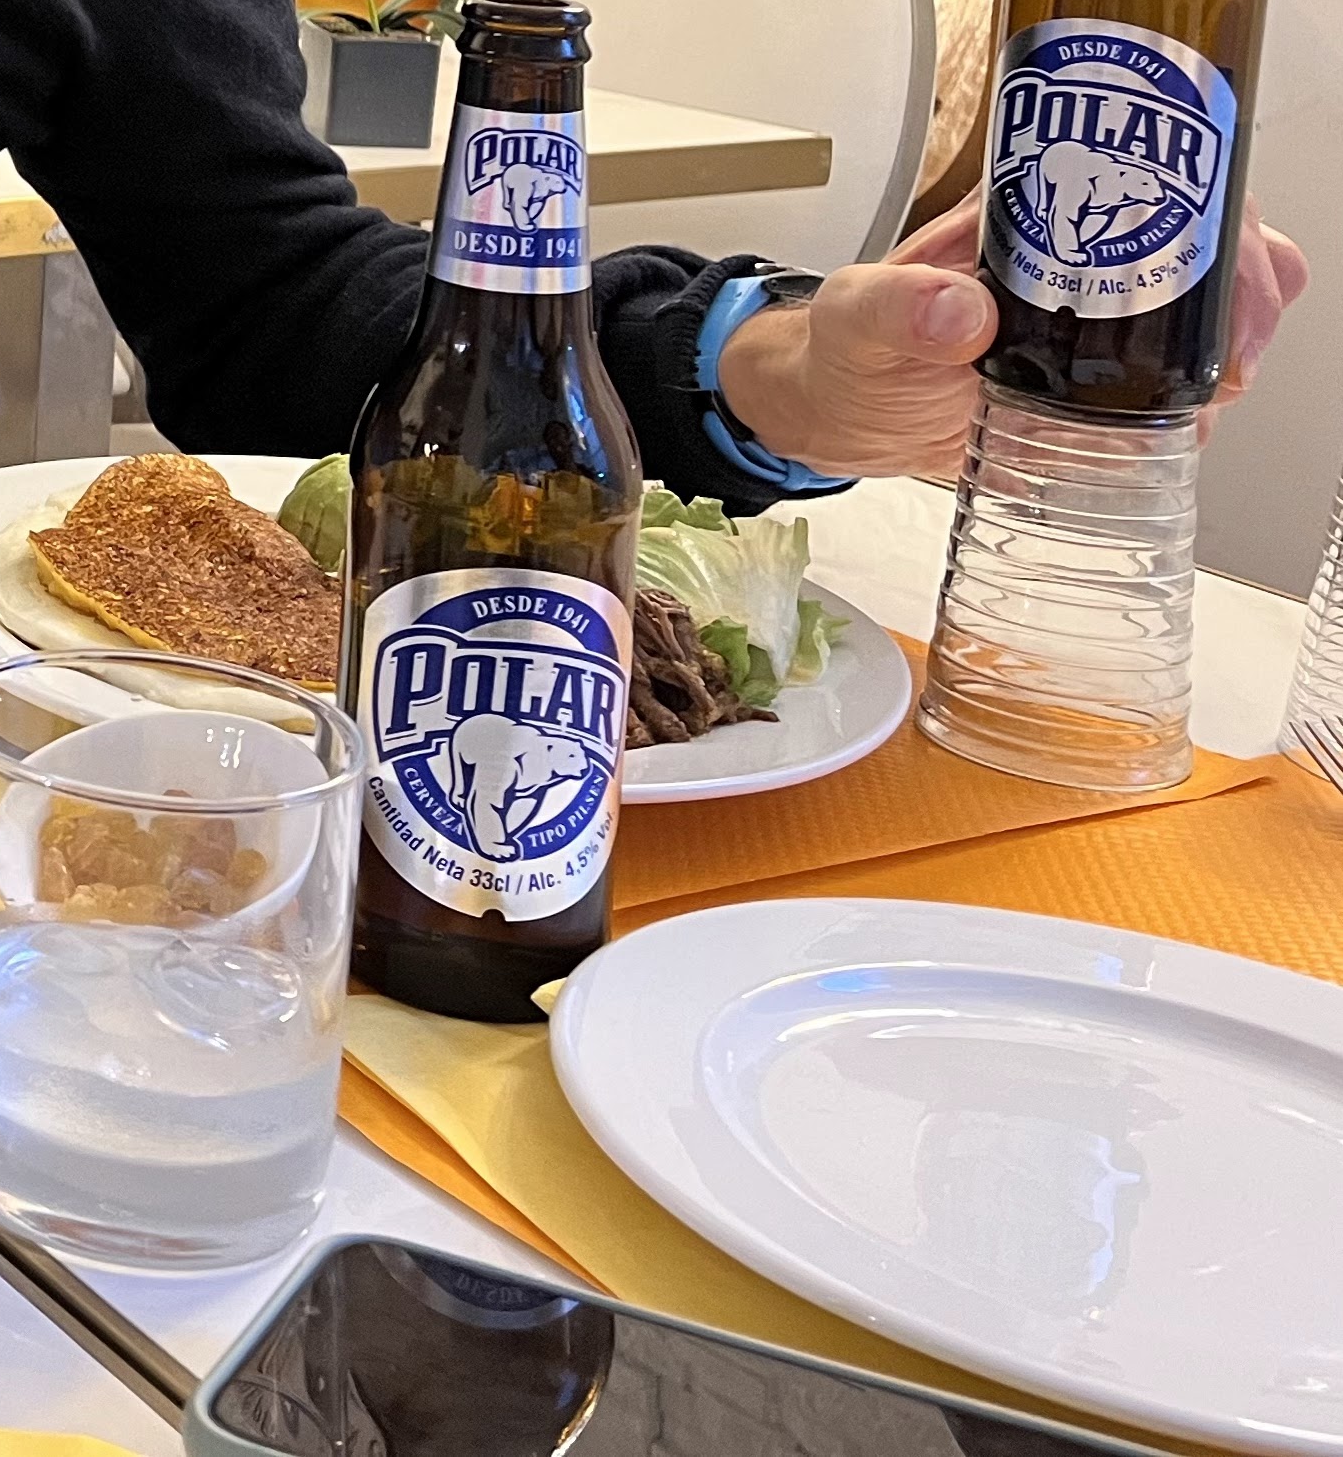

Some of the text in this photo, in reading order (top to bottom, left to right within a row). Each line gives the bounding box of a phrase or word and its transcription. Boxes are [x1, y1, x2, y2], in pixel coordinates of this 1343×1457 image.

[1058, 41, 1167, 80] DESDE 1941
[472, 133, 579, 183] POLAR
[996, 83, 1204, 188] POLAR
[454, 230, 582, 258] DESDE 1941
[1005, 188, 1046, 243] CERVEZA
[1099, 241, 1138, 258] TIPO
[1141, 204, 1185, 247] PILSEN
[1014, 251, 1044, 281] Neta
[1047, 271, 1081, 293] 33cl
[1098, 279, 1131, 295] Alc.
[1137, 261, 1178, 288] 4,5%
[1180, 243, 1205, 267] Vol.
[472, 595, 590, 634] DESDE 1941
[385, 643, 615, 748] POLAR
[369, 776, 420, 851] Cantidad
[423, 845, 465, 881] Neta
[469, 868, 510, 893] 33cl
[528, 871, 562, 893] Alc.
[565, 841, 599, 877] 4,5%
[404, 767, 604, 849] CERVEZA TIPO PILSEN
